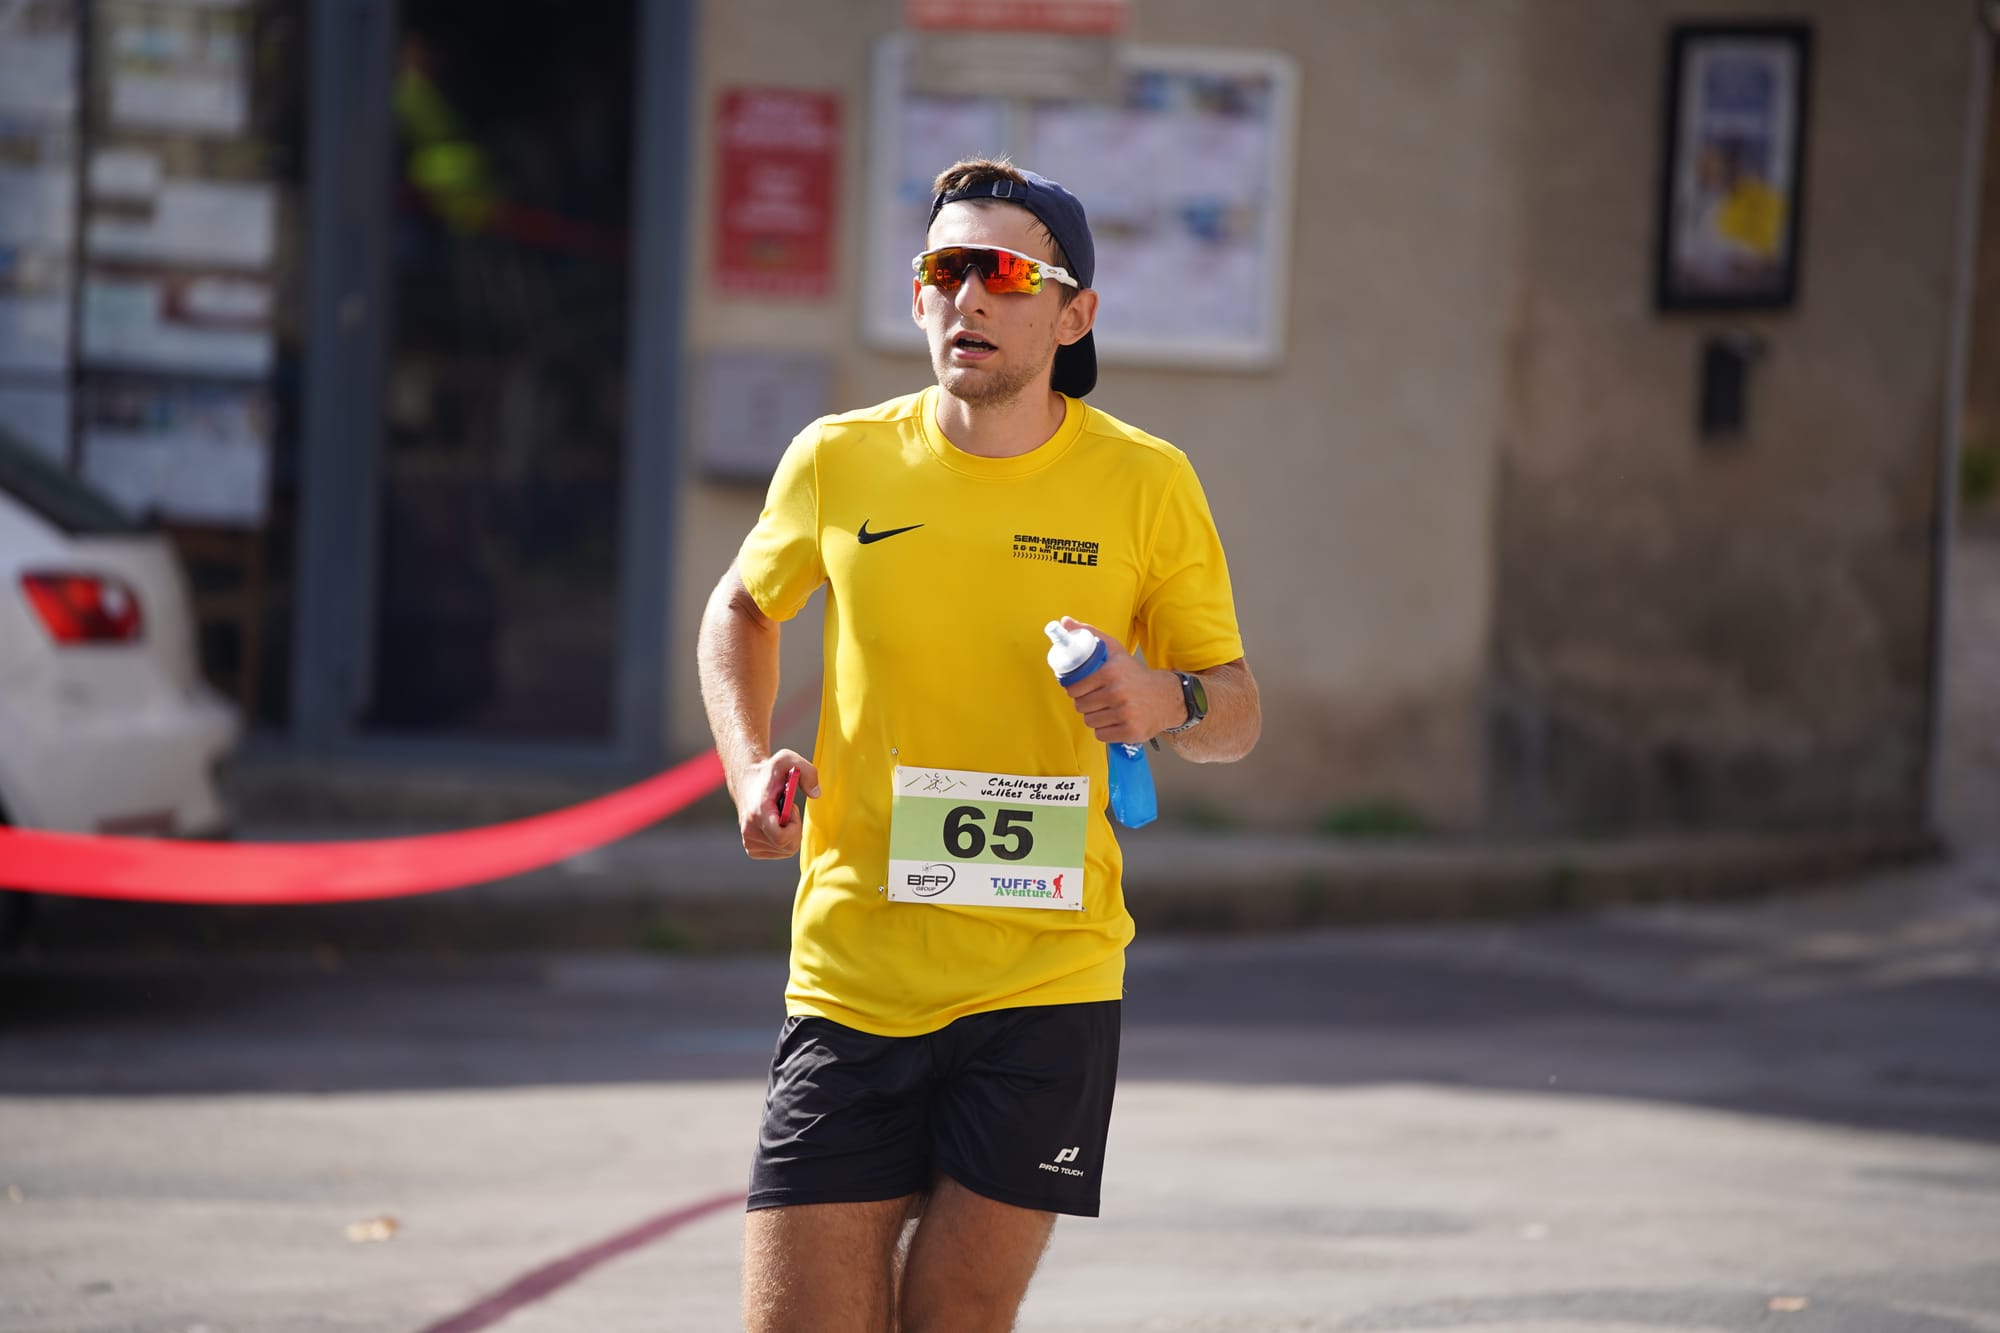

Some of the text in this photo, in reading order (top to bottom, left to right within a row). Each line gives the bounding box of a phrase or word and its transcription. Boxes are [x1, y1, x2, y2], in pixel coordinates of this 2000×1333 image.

[1014, 534, 1099, 550] SEMI-MARATHON
[988, 777, 1075, 791] Challenge des
[981, 788, 1081, 801] vallées cévenoles
[943, 805, 1034, 861] 65
[907, 874, 949, 887] BFP
[990, 877, 1047, 891] TUFF'S
[994, 888, 1052, 899] Aventure
[1038, 1162, 1084, 1177] PRO TOUCH
